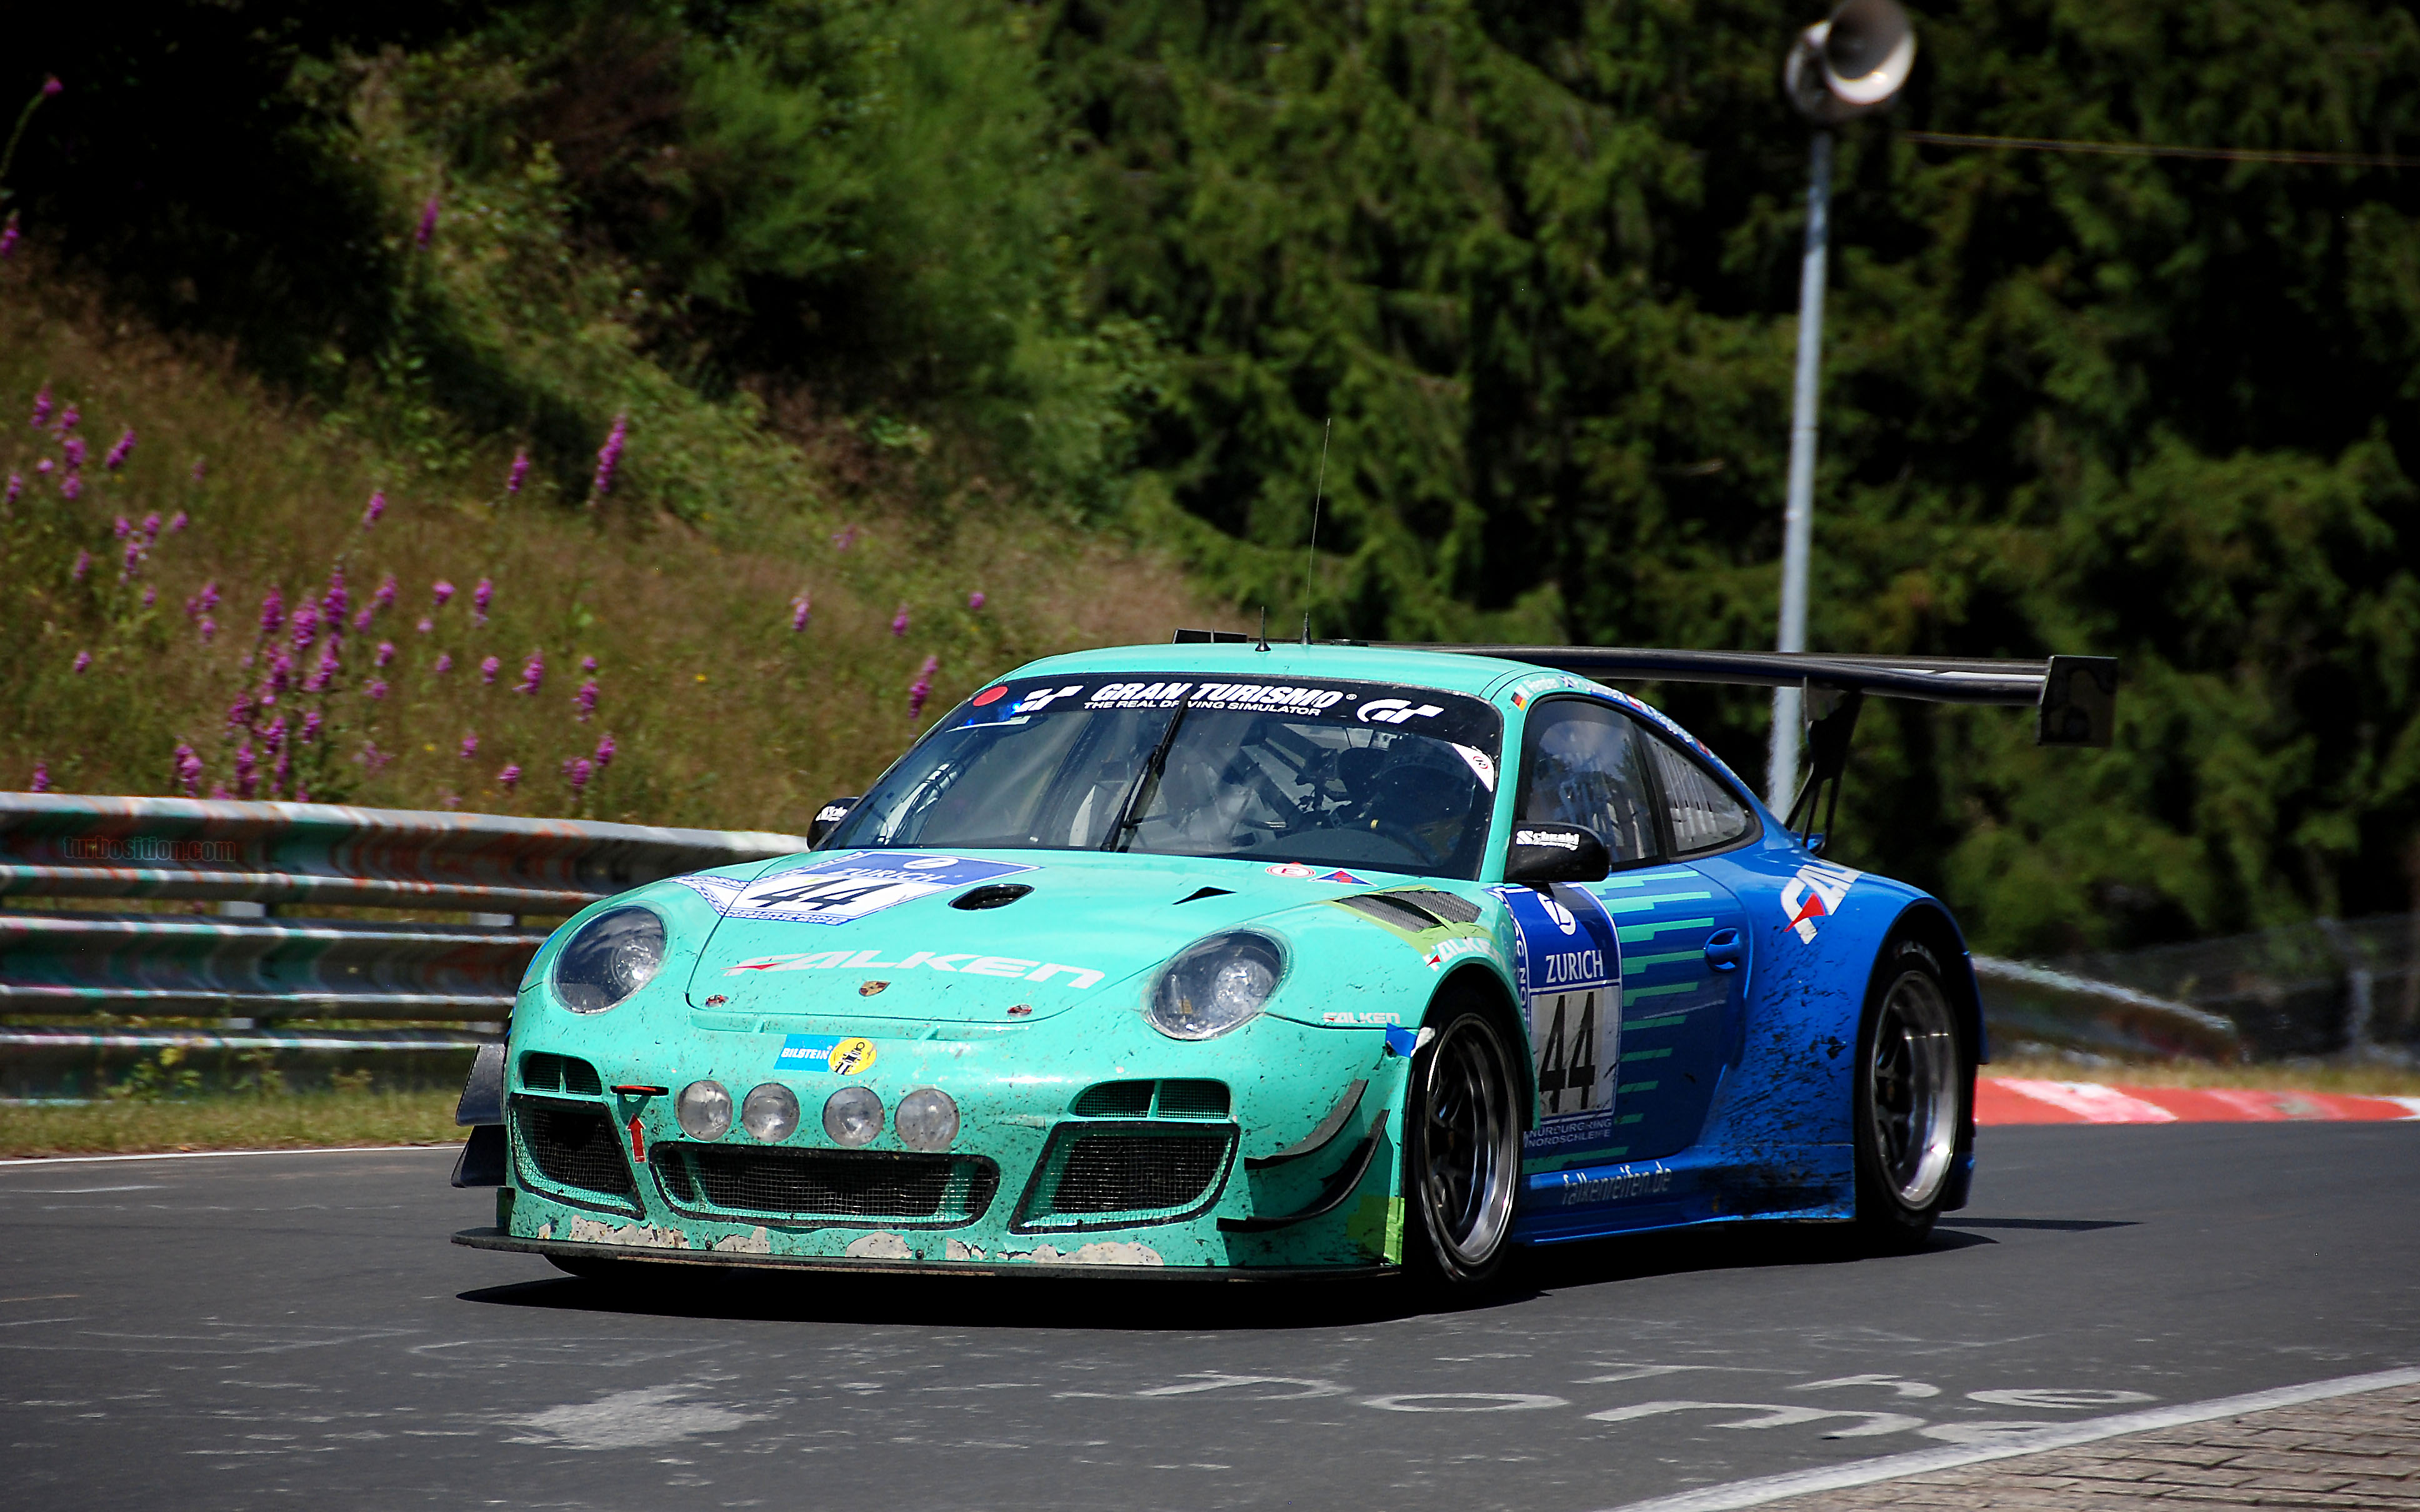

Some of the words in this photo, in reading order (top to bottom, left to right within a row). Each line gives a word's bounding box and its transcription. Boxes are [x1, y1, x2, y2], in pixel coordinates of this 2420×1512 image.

[1083, 701, 1113, 709] THE
[1116, 700, 1156, 709] REAL
[1159, 699, 1225, 710] DRVING
[1227, 702, 1322, 716] SIMULATOR
[1091, 682, 1193, 702] GRAN
[1189, 682, 1345, 709] TURISMO
[826, 867, 947, 882] ZURICH
[747, 878, 904, 911] 44
[721, 950, 1106, 989] FALKEN
[1546, 949, 1604, 983] ZURICH
[1322, 1012, 1401, 1024] FALKEN
[781, 1047, 829, 1060] BILSTEIN
[1539, 992, 1596, 1113] 44
